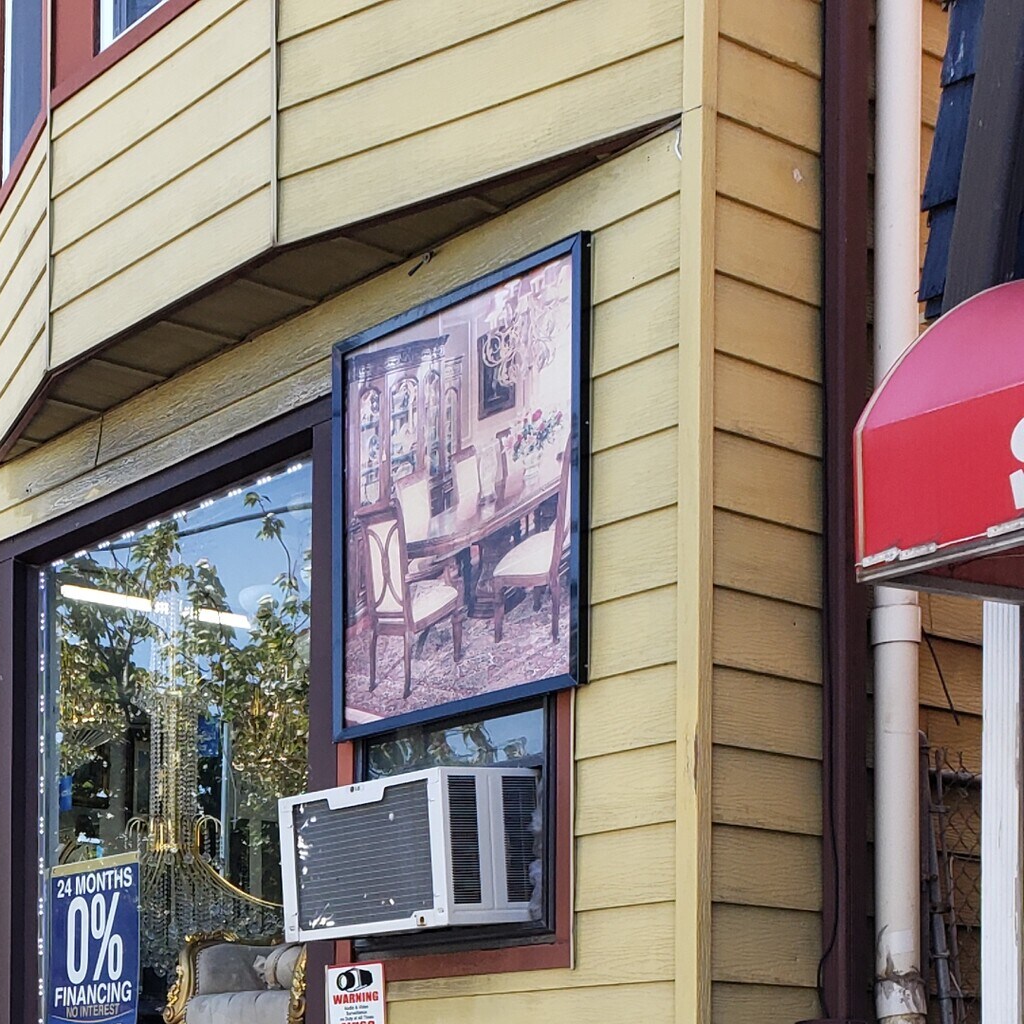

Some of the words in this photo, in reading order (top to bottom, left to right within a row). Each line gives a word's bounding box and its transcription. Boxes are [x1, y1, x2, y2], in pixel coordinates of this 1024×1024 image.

[57, 877, 72, 898] 24
[75, 866, 133, 895] MONTHS
[67, 891, 124, 985] 0%
[54, 980, 132, 1008] FINANCING
[333, 991, 379, 1005] WARNING
[66, 1006, 78, 1018] NO
[80, 1003, 120, 1017] INTEREST
